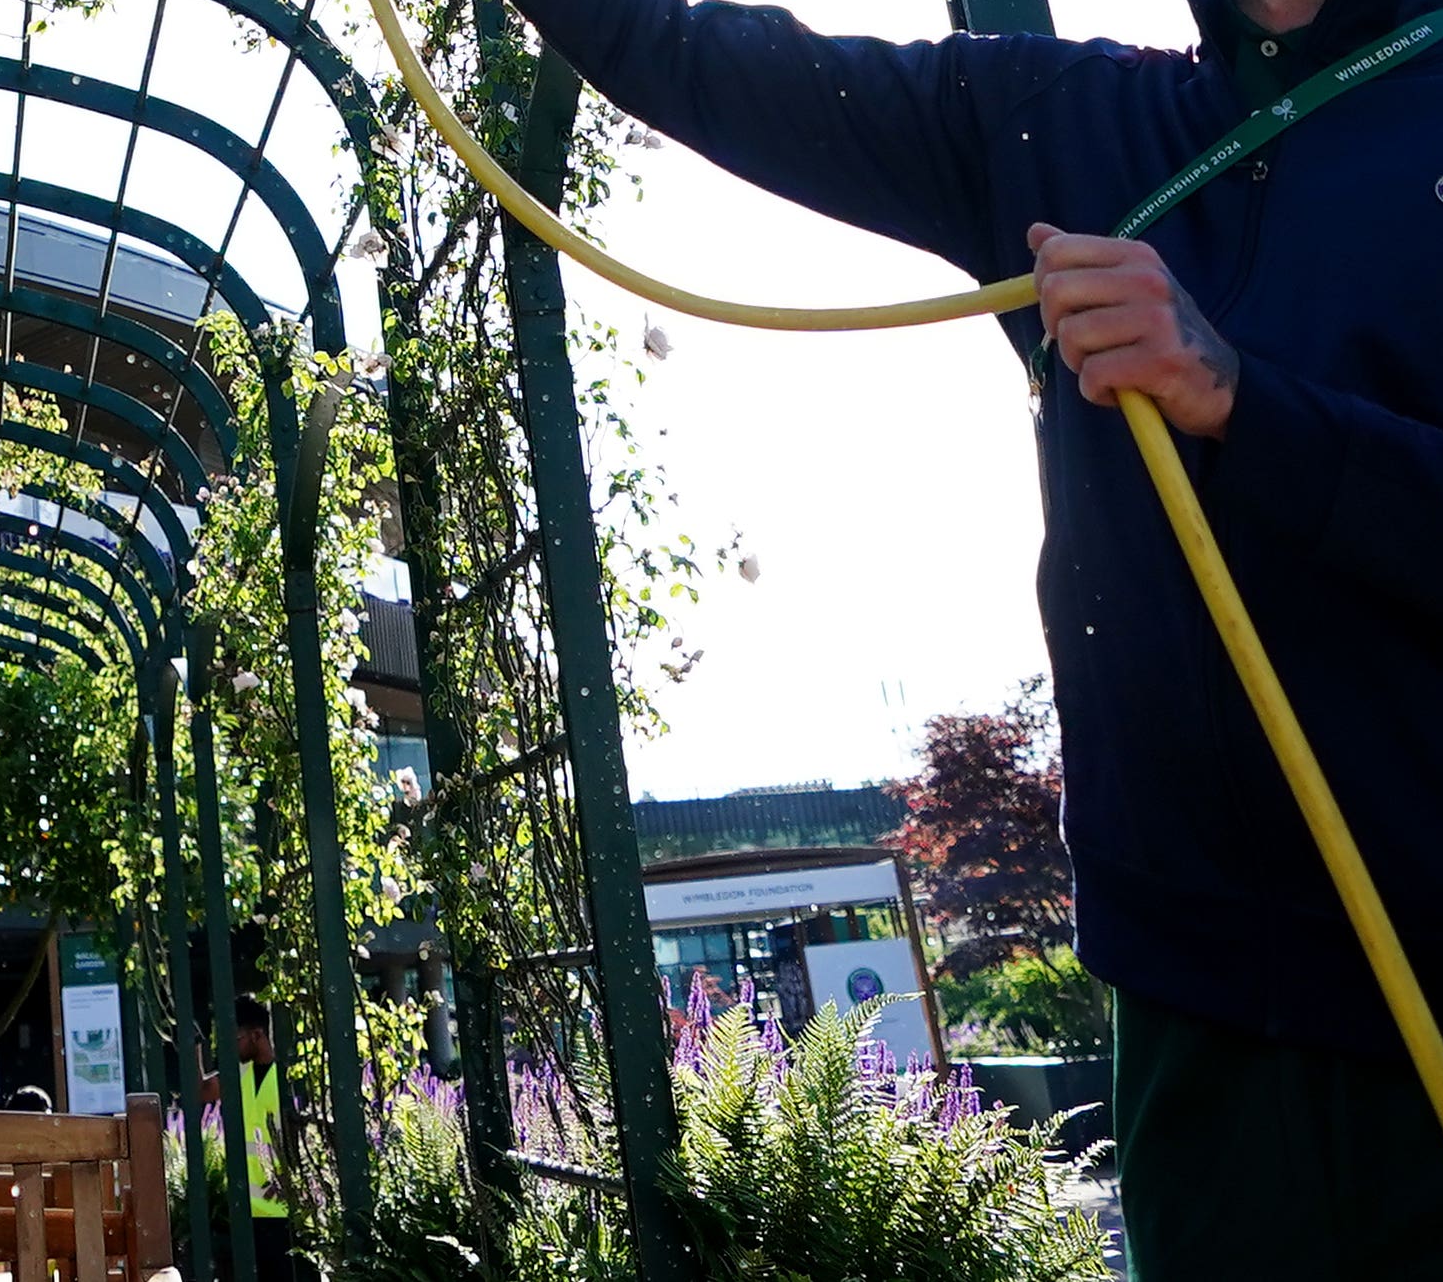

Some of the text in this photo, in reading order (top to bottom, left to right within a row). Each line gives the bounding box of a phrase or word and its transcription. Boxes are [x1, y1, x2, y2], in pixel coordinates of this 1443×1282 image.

[1335, 25, 1433, 82] WIMBLEDON.COM
[1117, 139, 1242, 241] CHAMPIONSHIPS 2024
[682, 883, 814, 904] WIMBLEDON FOUNDATION
